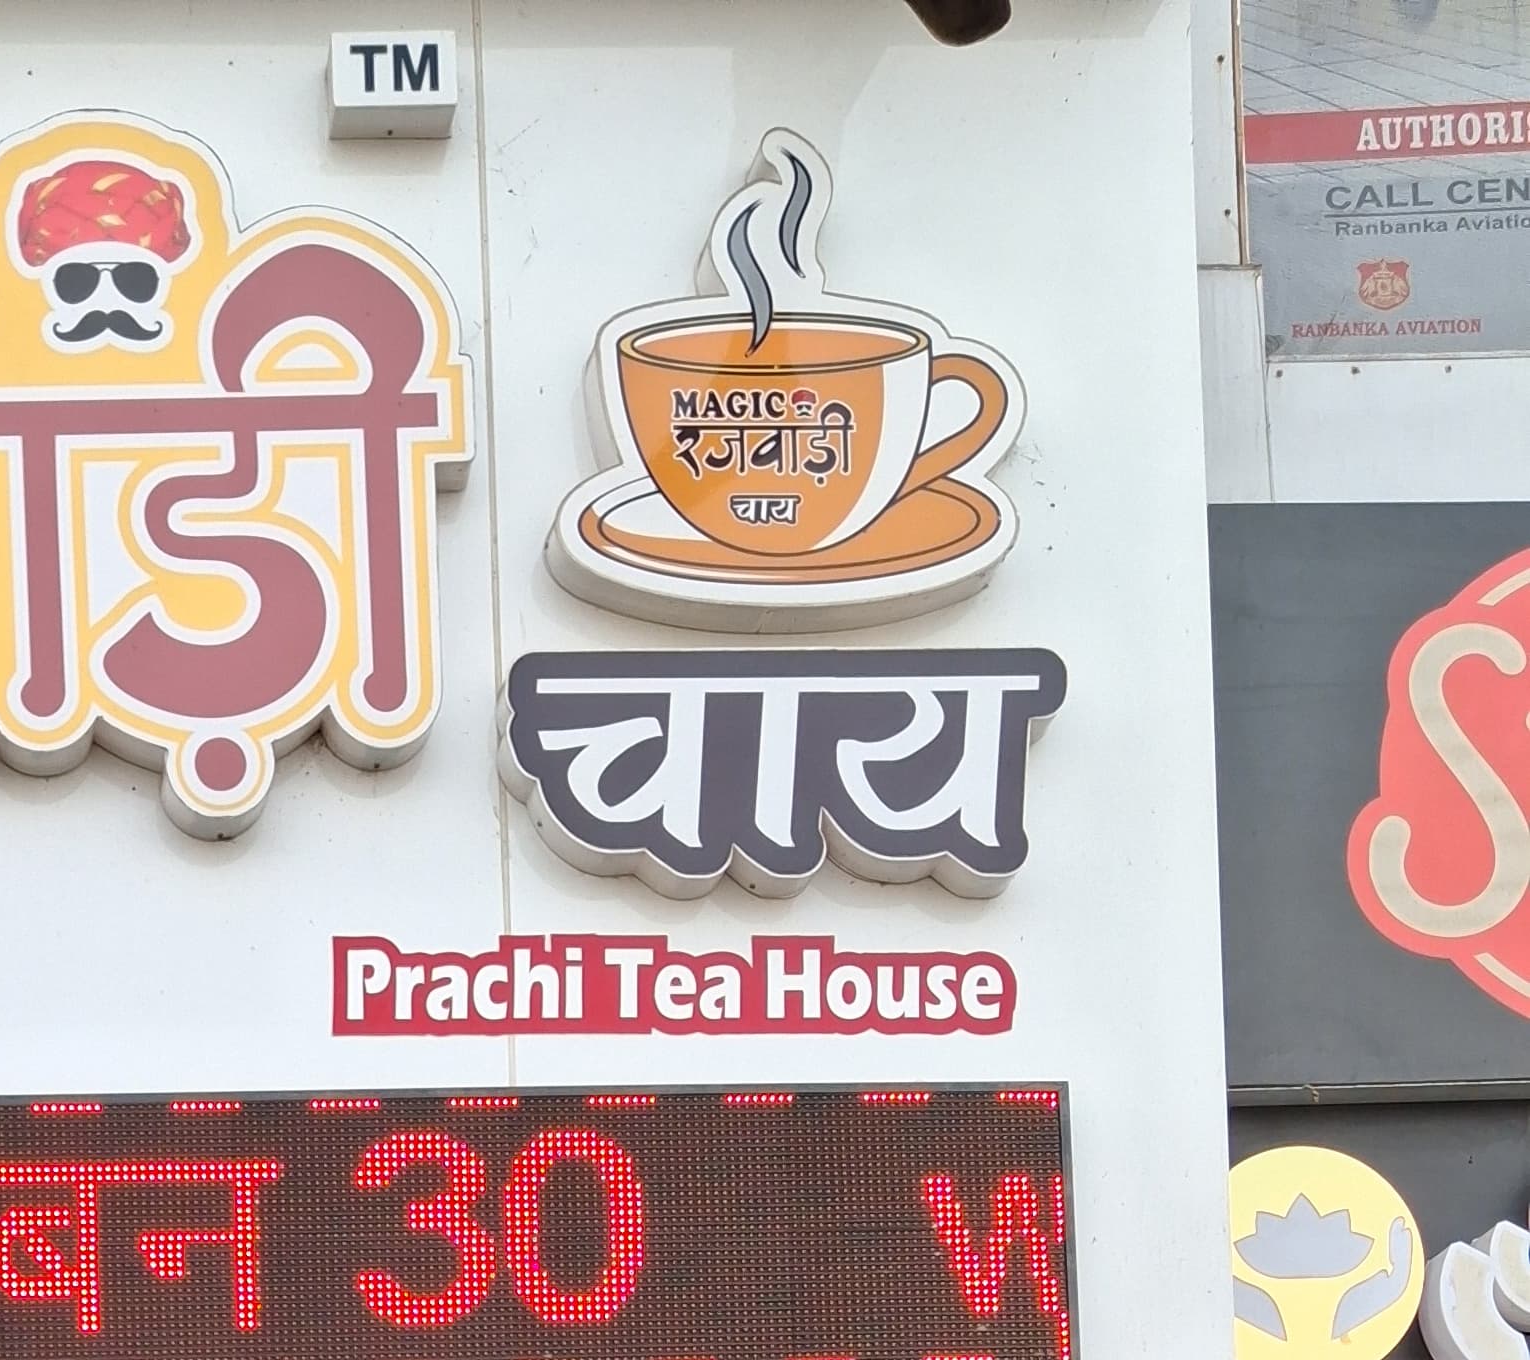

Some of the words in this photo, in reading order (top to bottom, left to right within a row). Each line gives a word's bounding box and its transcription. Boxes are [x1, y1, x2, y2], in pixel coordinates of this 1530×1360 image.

[350, 43, 440, 92] TM
[1356, 110, 1530, 151] AUTHORI
[1325, 182, 1433, 210] CALL
[1446, 177, 1530, 204] CEN
[1336, 218, 1448, 236] Ranbanka
[1292, 321, 1389, 338] RANBANKA
[1396, 317, 1482, 335] AVIATION
[673, 391, 786, 418] MAGIC
[673, 402, 855, 485] रजवाड़ी
[731, 496, 800, 522] चाय
[536, 675, 1039, 847] चाय
[1370, 622, 1530, 938] S
[346, 947, 586, 1021] Prachi
[605, 948, 754, 1019] Tea
[768, 948, 1005, 1021] House
[353, 1127, 646, 1327] 30
